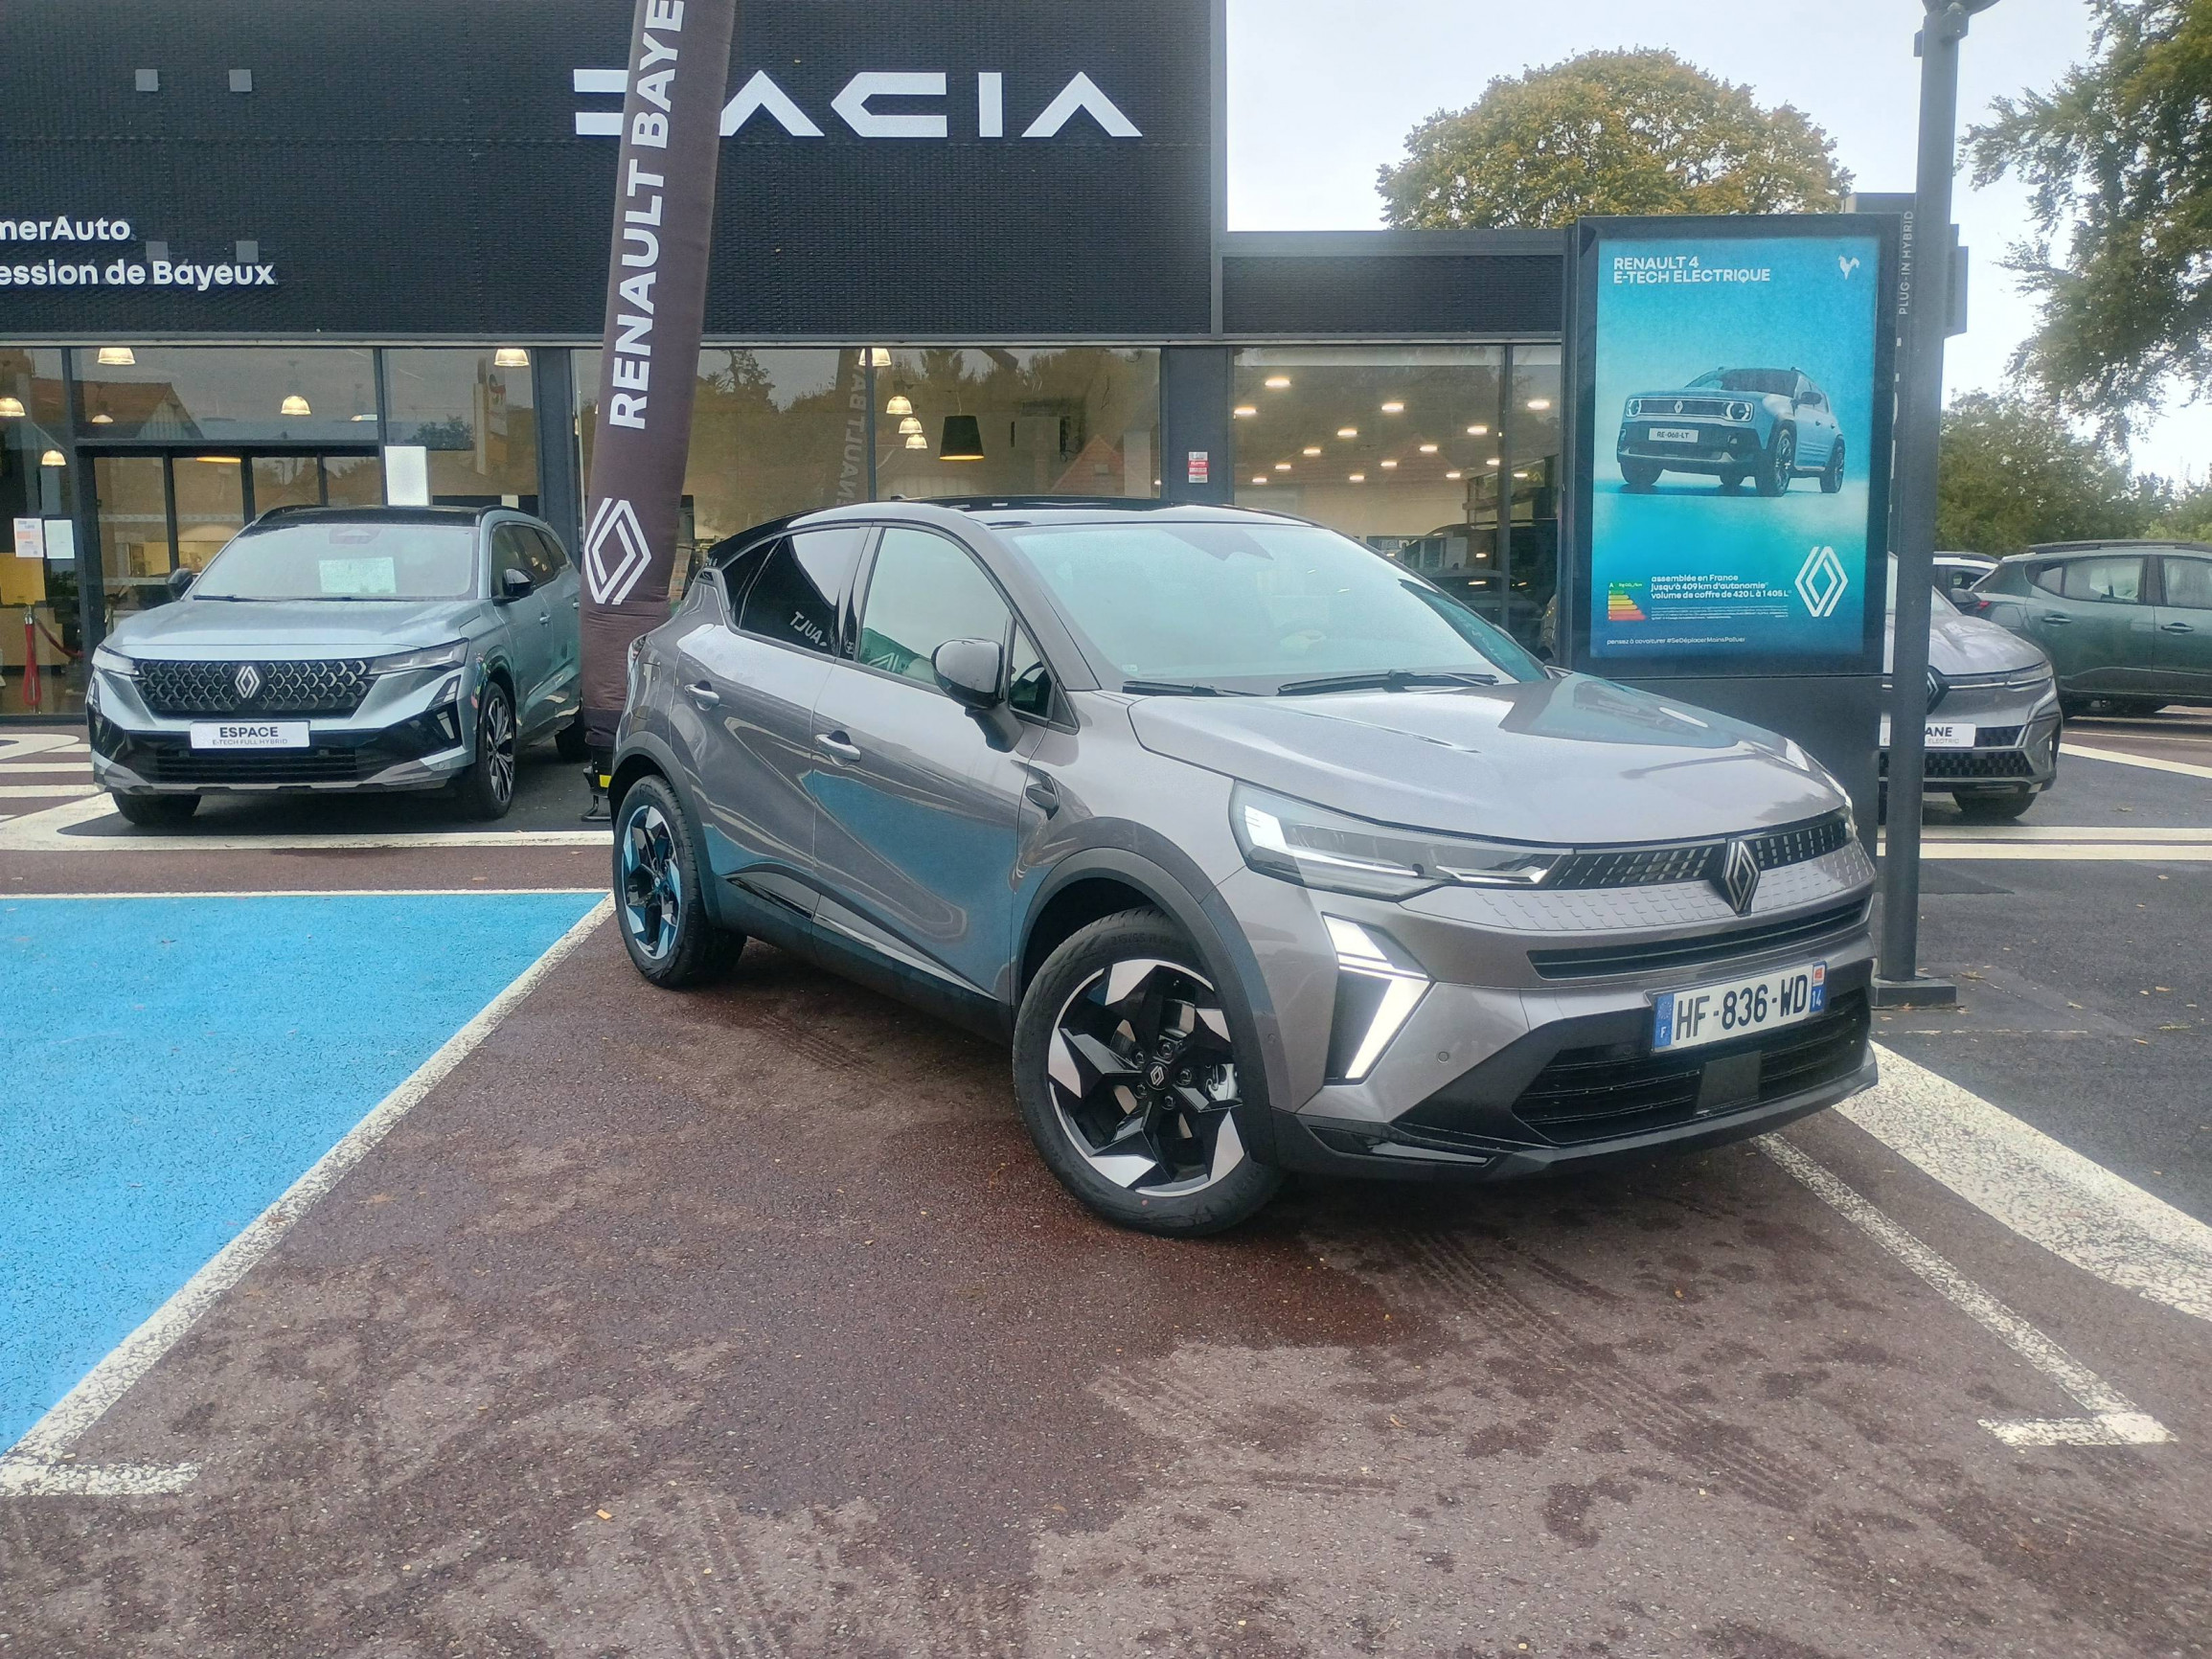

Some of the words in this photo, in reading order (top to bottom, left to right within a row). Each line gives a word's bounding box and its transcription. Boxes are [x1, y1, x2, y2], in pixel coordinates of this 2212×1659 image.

[1903, 210, 1916, 261] HYBRID
[1613, 256, 1687, 270] RENAULT
[1688, 256, 1699, 268] 4
[0, 260, 98, 285] ession
[104, 260, 146, 285] de
[152, 261, 275, 291] Bayeux
[1613, 270, 1670, 284] E-TECH
[1673, 268, 1770, 284] ELECTRIQUE
[609, 159, 664, 430] RENAULT
[1898, 262, 1912, 316] PLUG-IN
[1709, 574, 1739, 582] France
[1681, 582, 1698, 591] 409
[1694, 590, 1721, 599] coffre
[219, 726, 279, 738] ESPACE
[1812, 989, 1822, 1008] 14
[1676, 974, 1808, 1040] HF-836-WD
[1659, 1026, 1667, 1038] F
